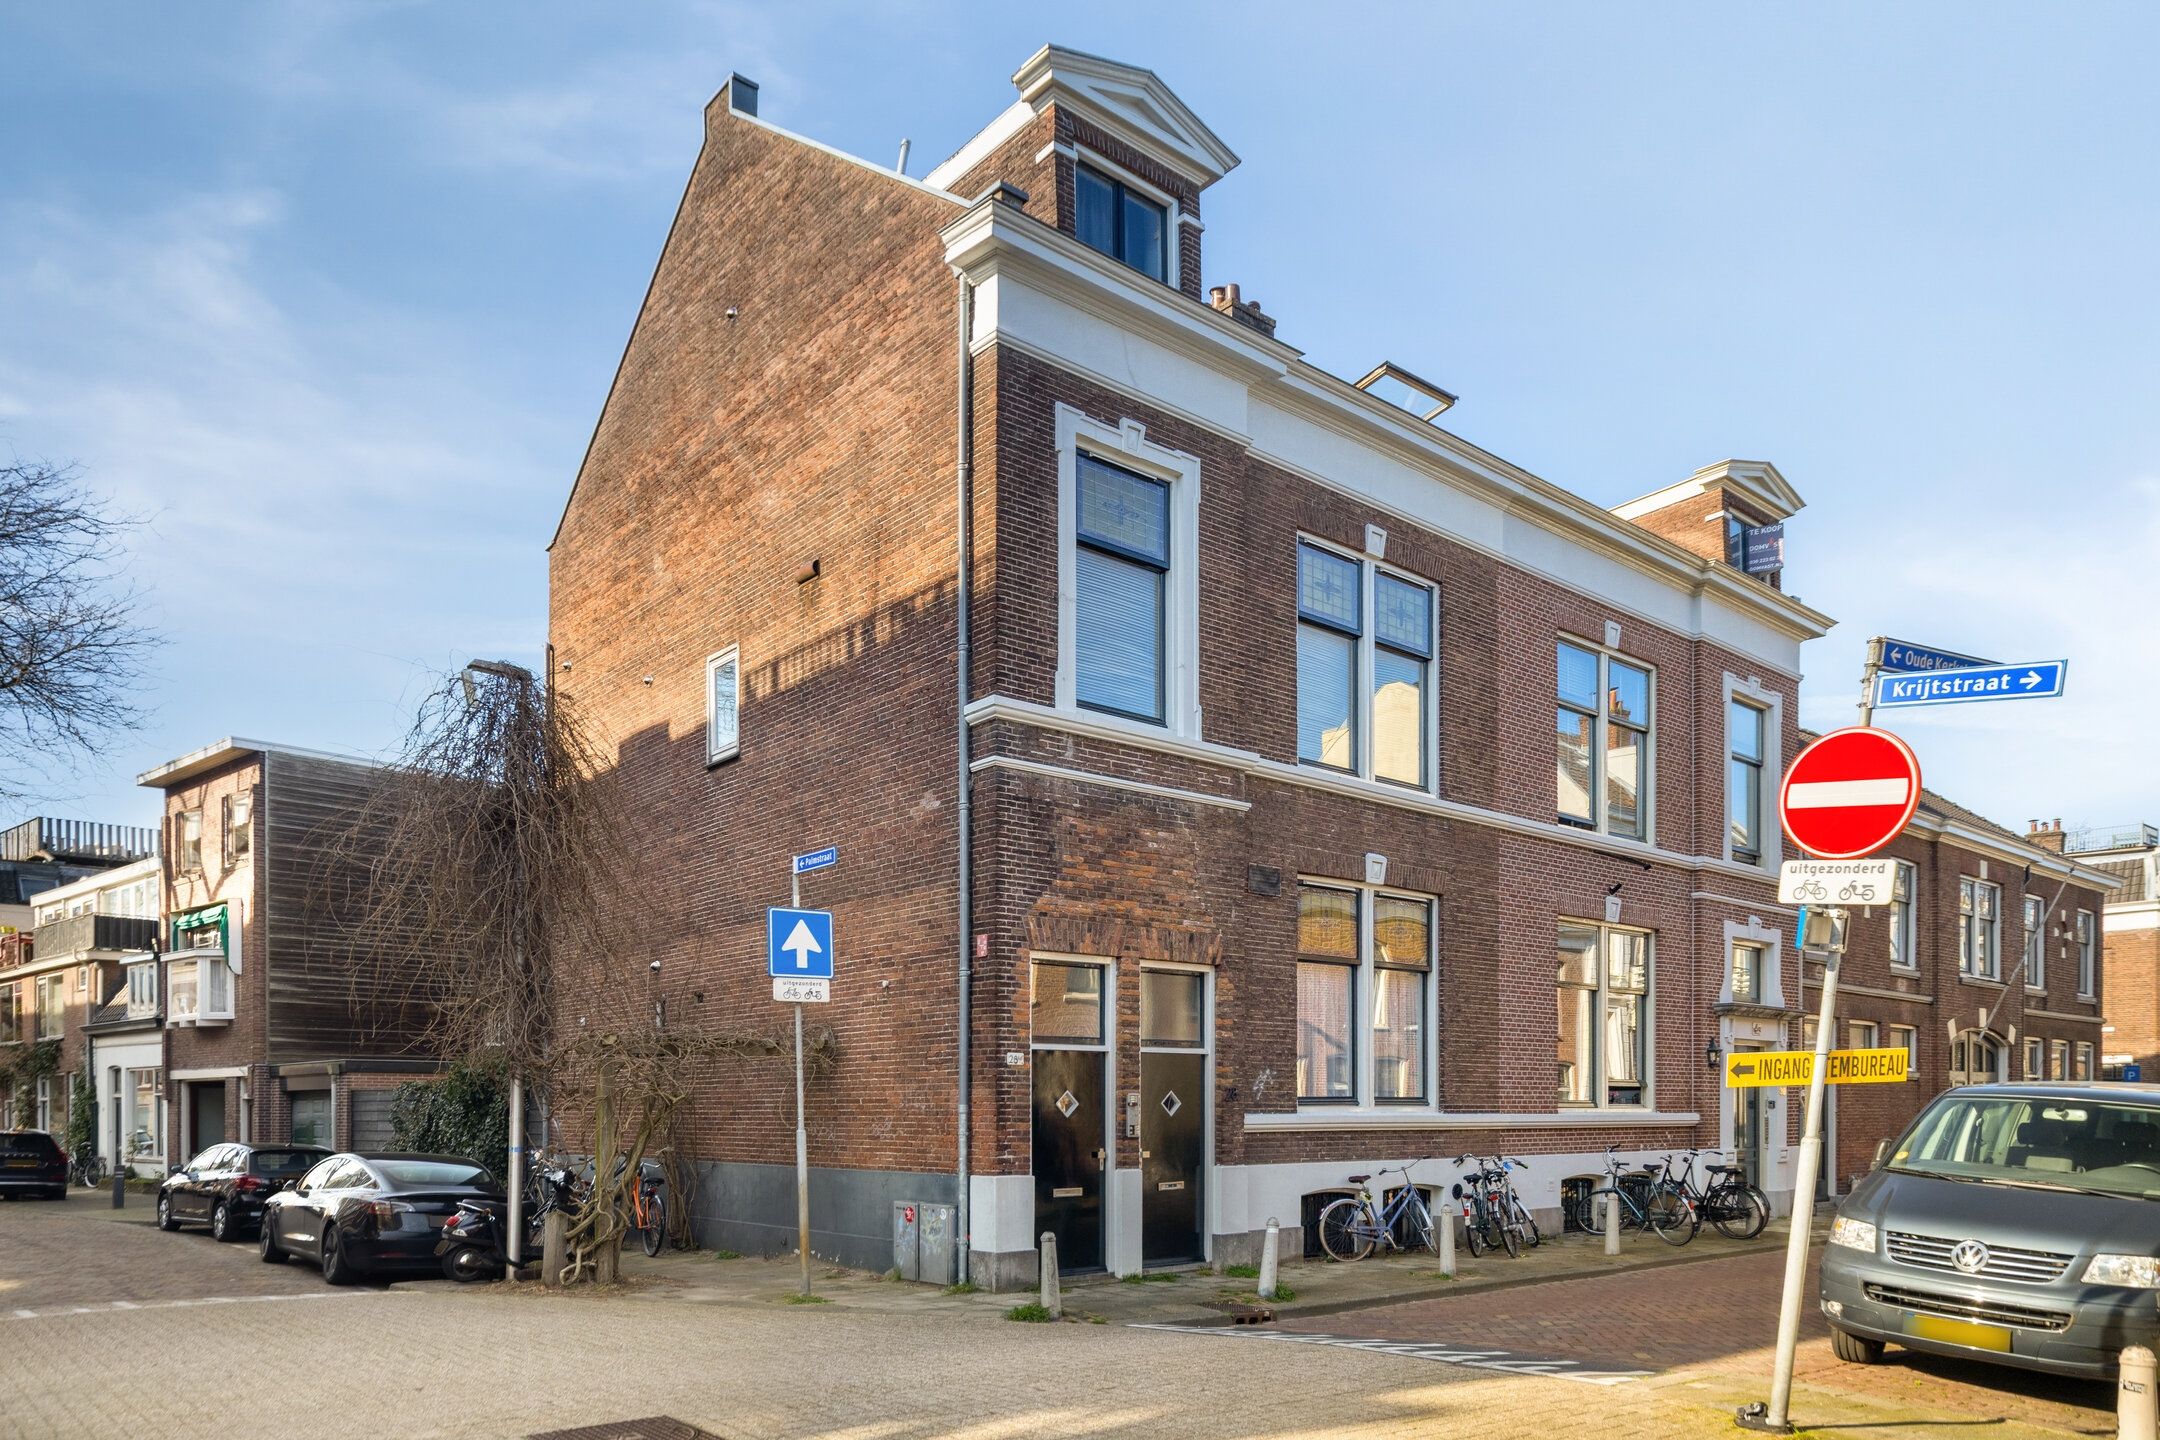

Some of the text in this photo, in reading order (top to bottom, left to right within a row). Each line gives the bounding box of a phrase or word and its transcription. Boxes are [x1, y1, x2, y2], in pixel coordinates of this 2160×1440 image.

[1761, 525, 1782, 534] KOOP
[1905, 650, 1934, 669] Oude
[1892, 674, 2011, 699] Krijtstraat
[1790, 863, 1886, 876] uitgezonderd
[1758, 1054, 1905, 1081] INGANG TEMBUREAU
[2128, 1072, 2136, 1080] P
